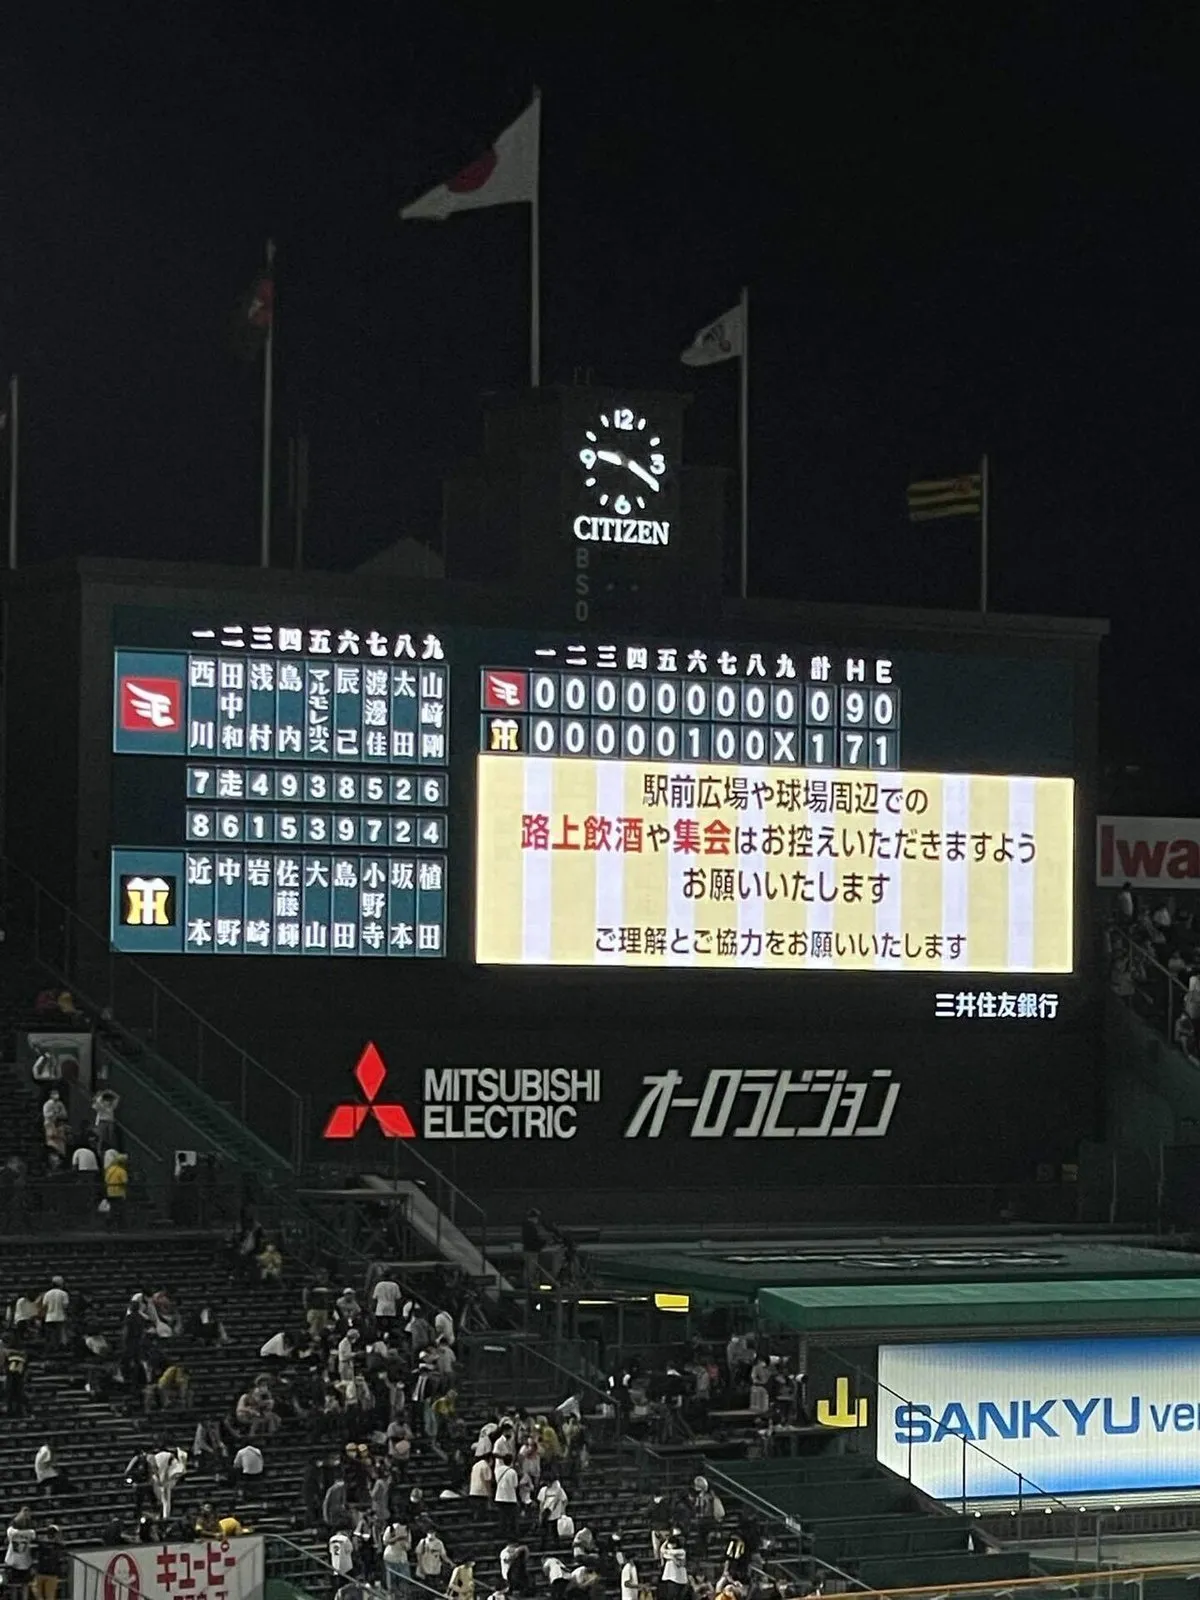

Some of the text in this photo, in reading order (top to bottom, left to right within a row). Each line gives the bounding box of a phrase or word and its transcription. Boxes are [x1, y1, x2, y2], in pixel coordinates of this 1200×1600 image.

[613, 408, 634, 431] 12
[579, 449, 597, 470] 9
[650, 454, 666, 475] 3
[614, 495, 631, 515] 6
[573, 515, 670, 545] CITIZEN
[576, 548, 589, 569] B
[576, 574, 589, 595] S
[535, 677, 893, 725] 0 0 0 0 0 0 0 0 0 0 9 0
[535, 720, 887, 766] 0 0 0 0 0 1 0 0 X 1 7 1
[193, 769, 440, 802] 7 走 4 9 3 8 5 2 6
[642, 773, 928, 815] 駅前広場や球場周辺での
[193, 814, 439, 844] 8 6 1 5 3 9 7 2 4
[521, 813, 1037, 863] 路上飲酒や集会はお控えいただきますよう
[682, 867, 891, 903] お願いいたします
[595, 926, 967, 960] ご理解とご協力をお願いいたします
[935, 991, 1058, 1019] 三井住友銀行
[424, 1068, 601, 1103] MITSUBISHI
[624, 1068, 901, 1138] オーロラビジョン
[424, 1104, 578, 1139] ELECTRIC
[895, 1396, 1200, 1443] SANKYU ve
